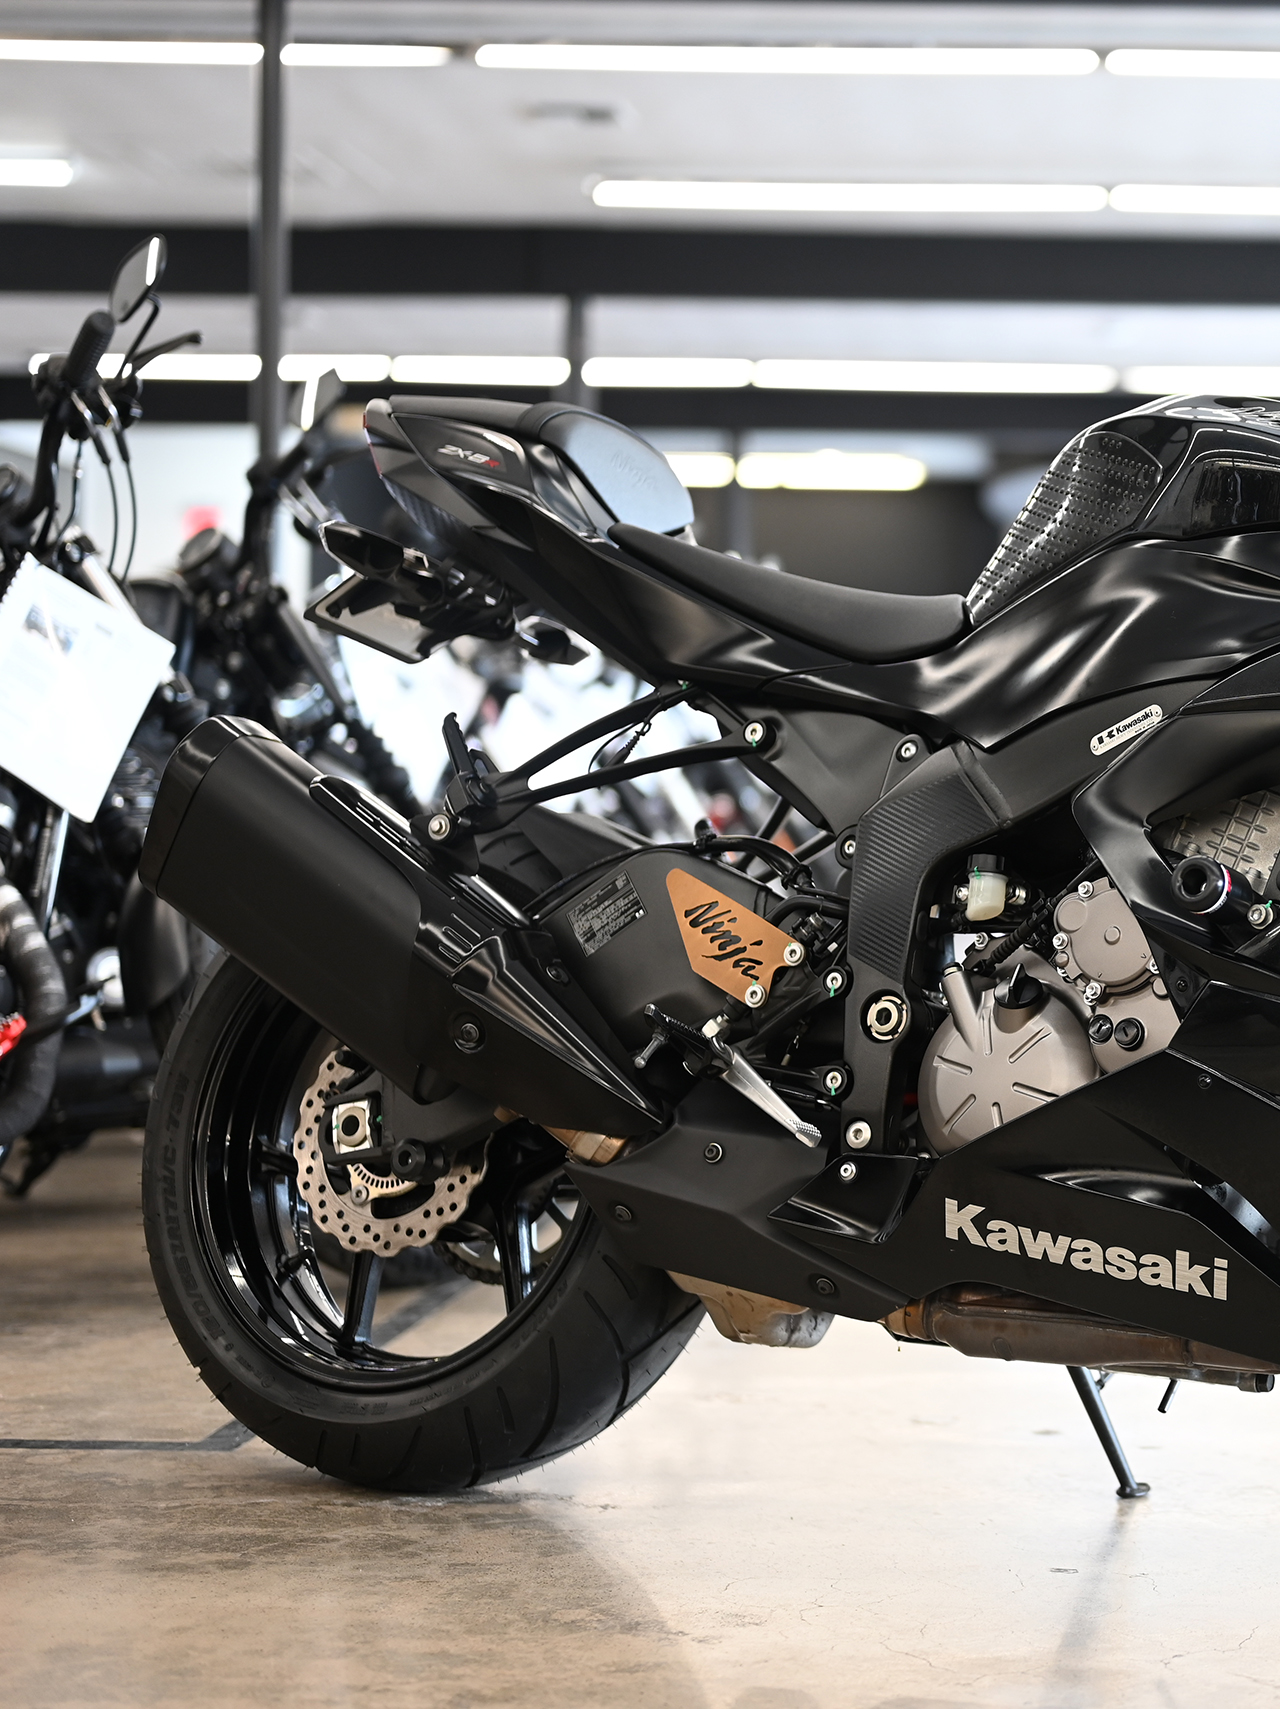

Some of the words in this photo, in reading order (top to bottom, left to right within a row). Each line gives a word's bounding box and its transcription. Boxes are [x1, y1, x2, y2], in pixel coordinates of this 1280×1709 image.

[1115, 708, 1154, 735] Kawasaki
[684, 900, 764, 982] Ninja
[945, 1197, 1228, 1301] Kawasaki
